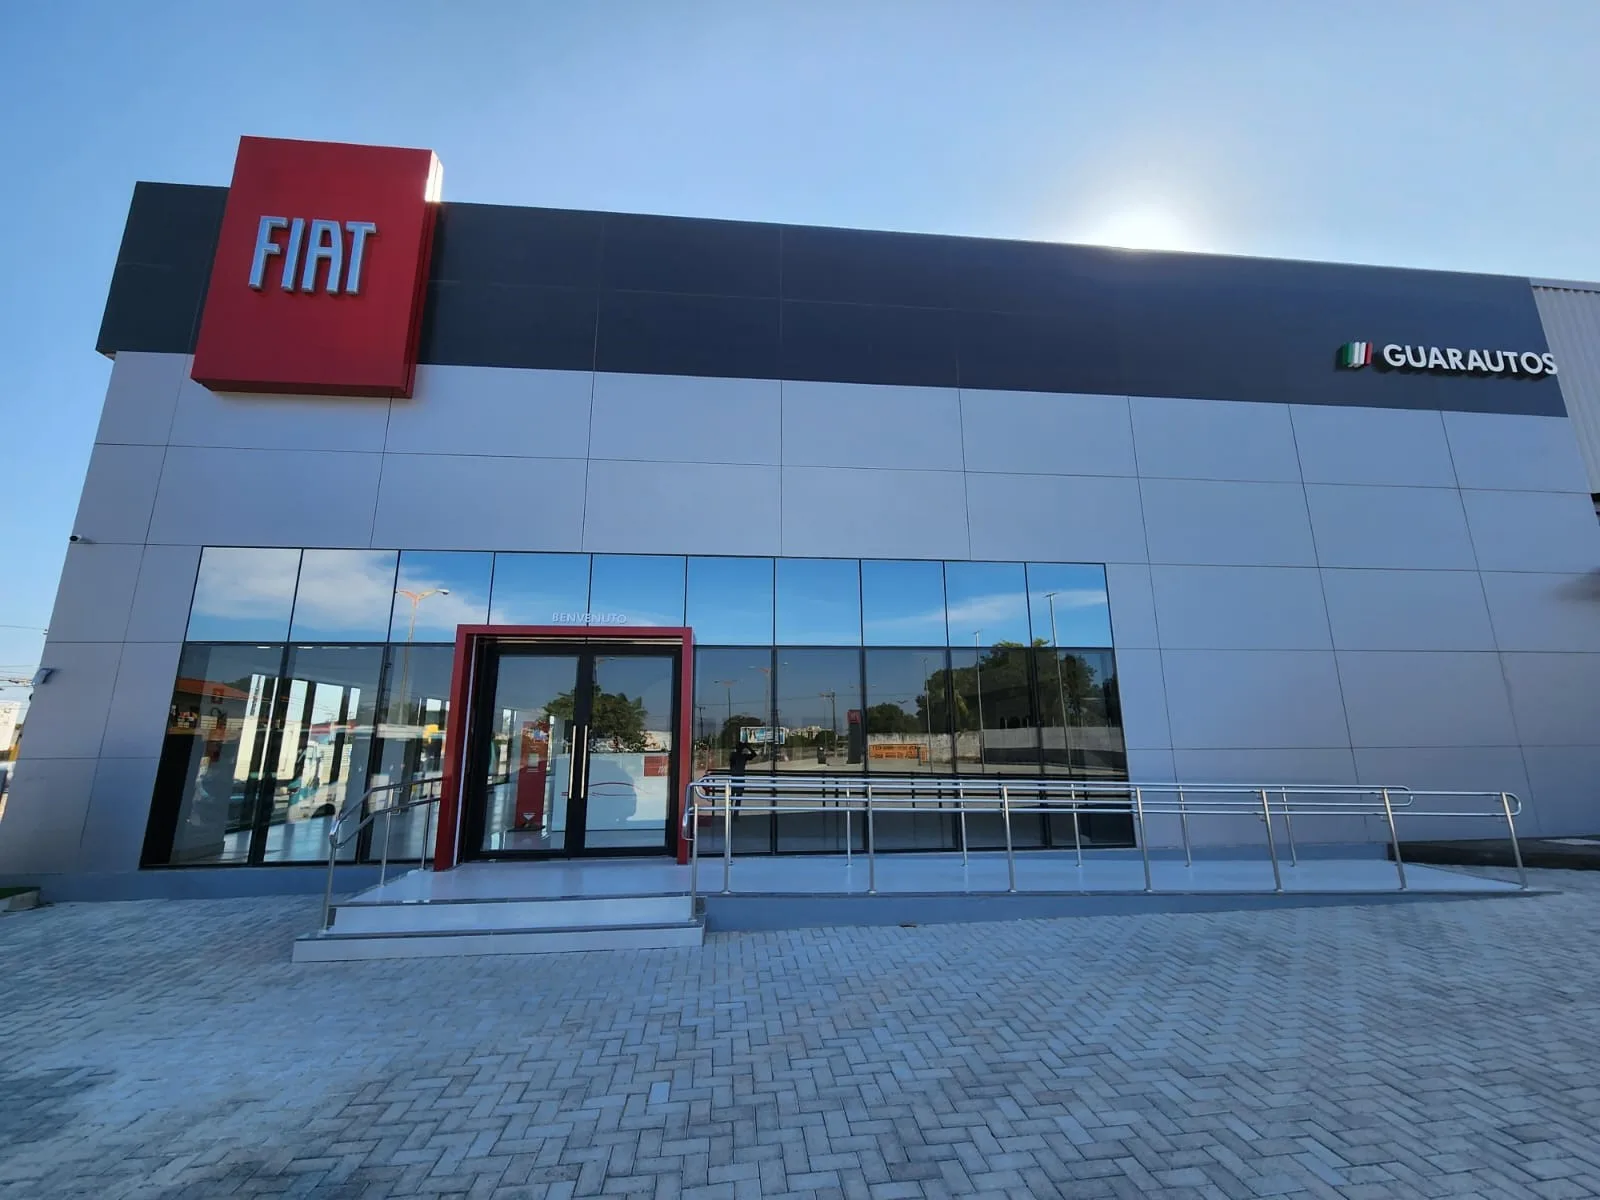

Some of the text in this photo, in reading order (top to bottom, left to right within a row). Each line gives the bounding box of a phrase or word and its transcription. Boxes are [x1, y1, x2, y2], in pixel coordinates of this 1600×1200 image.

[248, 215, 376, 294] FIAT
[1383, 343, 1558, 375] GUARAUTOS
[552, 612, 627, 624] BENVENUTO
